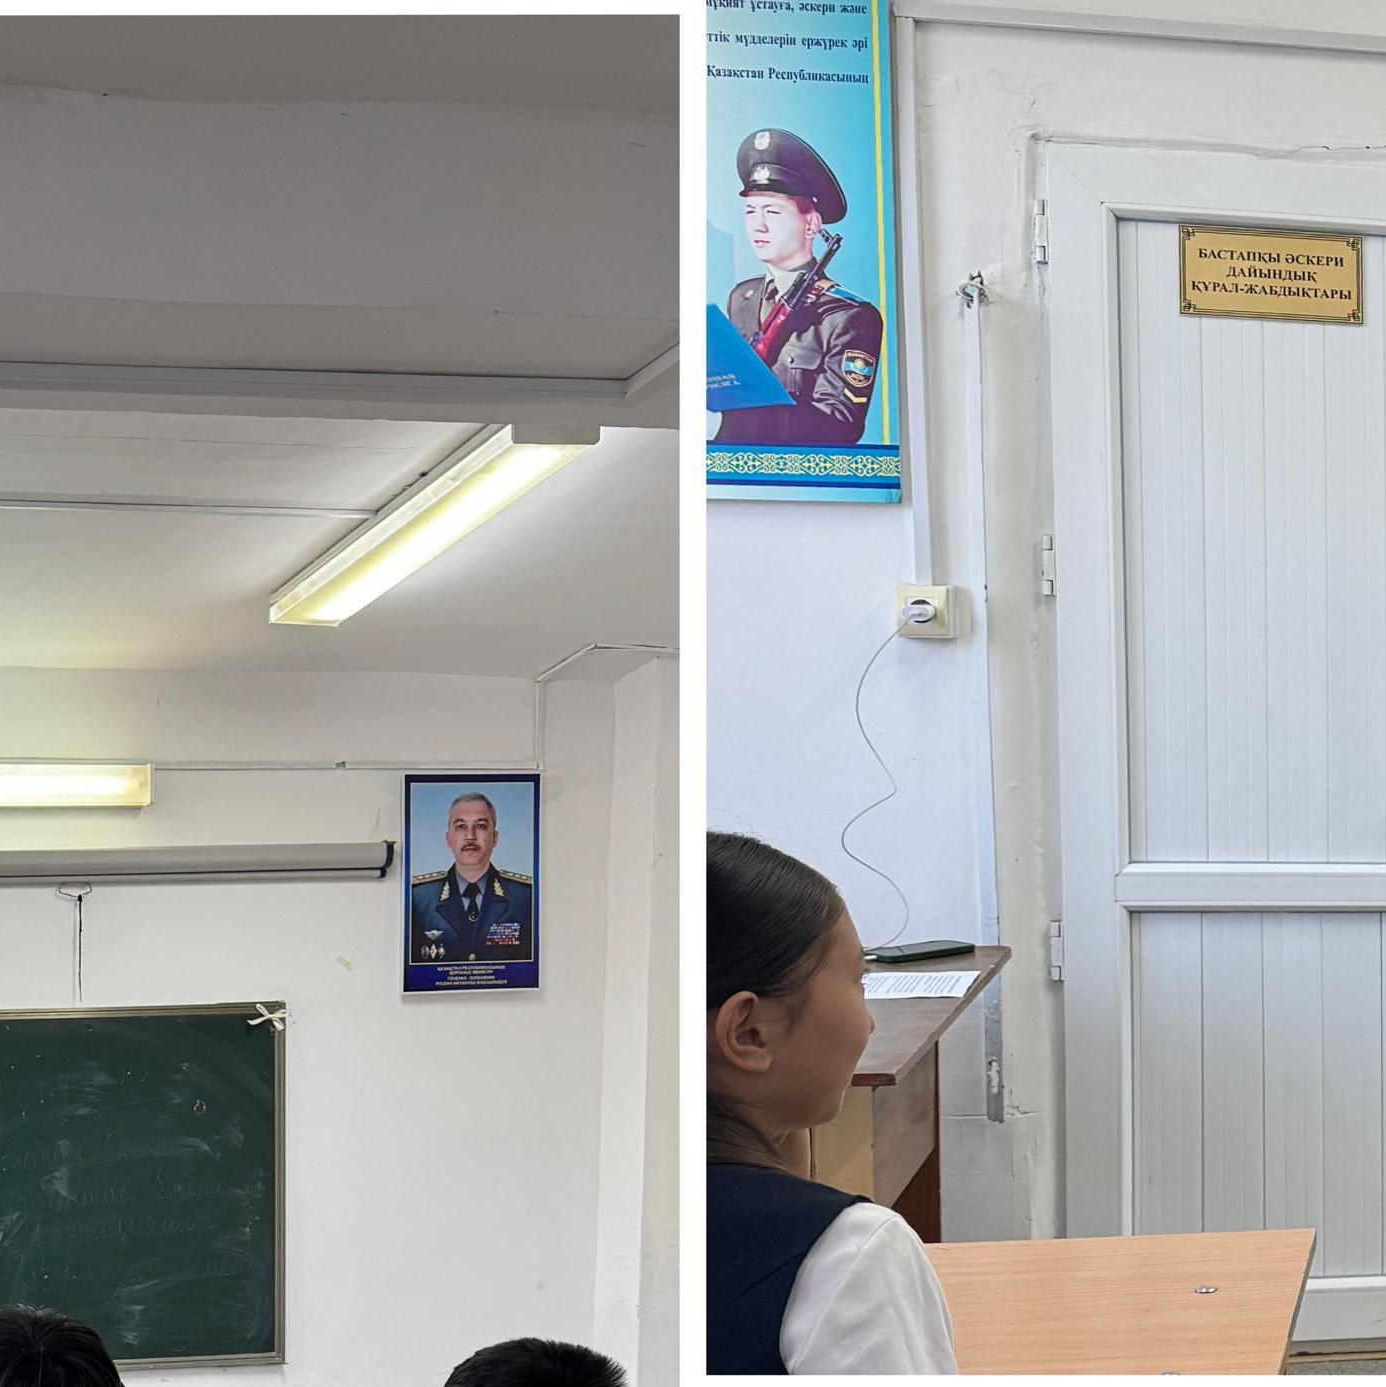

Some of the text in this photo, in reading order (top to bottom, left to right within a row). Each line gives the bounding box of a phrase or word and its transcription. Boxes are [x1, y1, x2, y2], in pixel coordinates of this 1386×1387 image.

[799, 3, 835, 15] әскери
[840, 5, 866, 14] және
[735, 34, 796, 47] мүдделерін
[802, 38, 847, 50] ержүрек
[852, 37, 868, 51] әрі
[707, 65, 868, 83] Қазақстан Республикасының
[1198, 248, 1344, 267] БАСТАПҚЫ ӘСКЕРИ
[1227, 266, 1317, 283] ДАЙЫНДЫҚ
[1191, 281, 1351, 300] ҚҰРАЛ-ЖАБДЫҚТАРЫ
